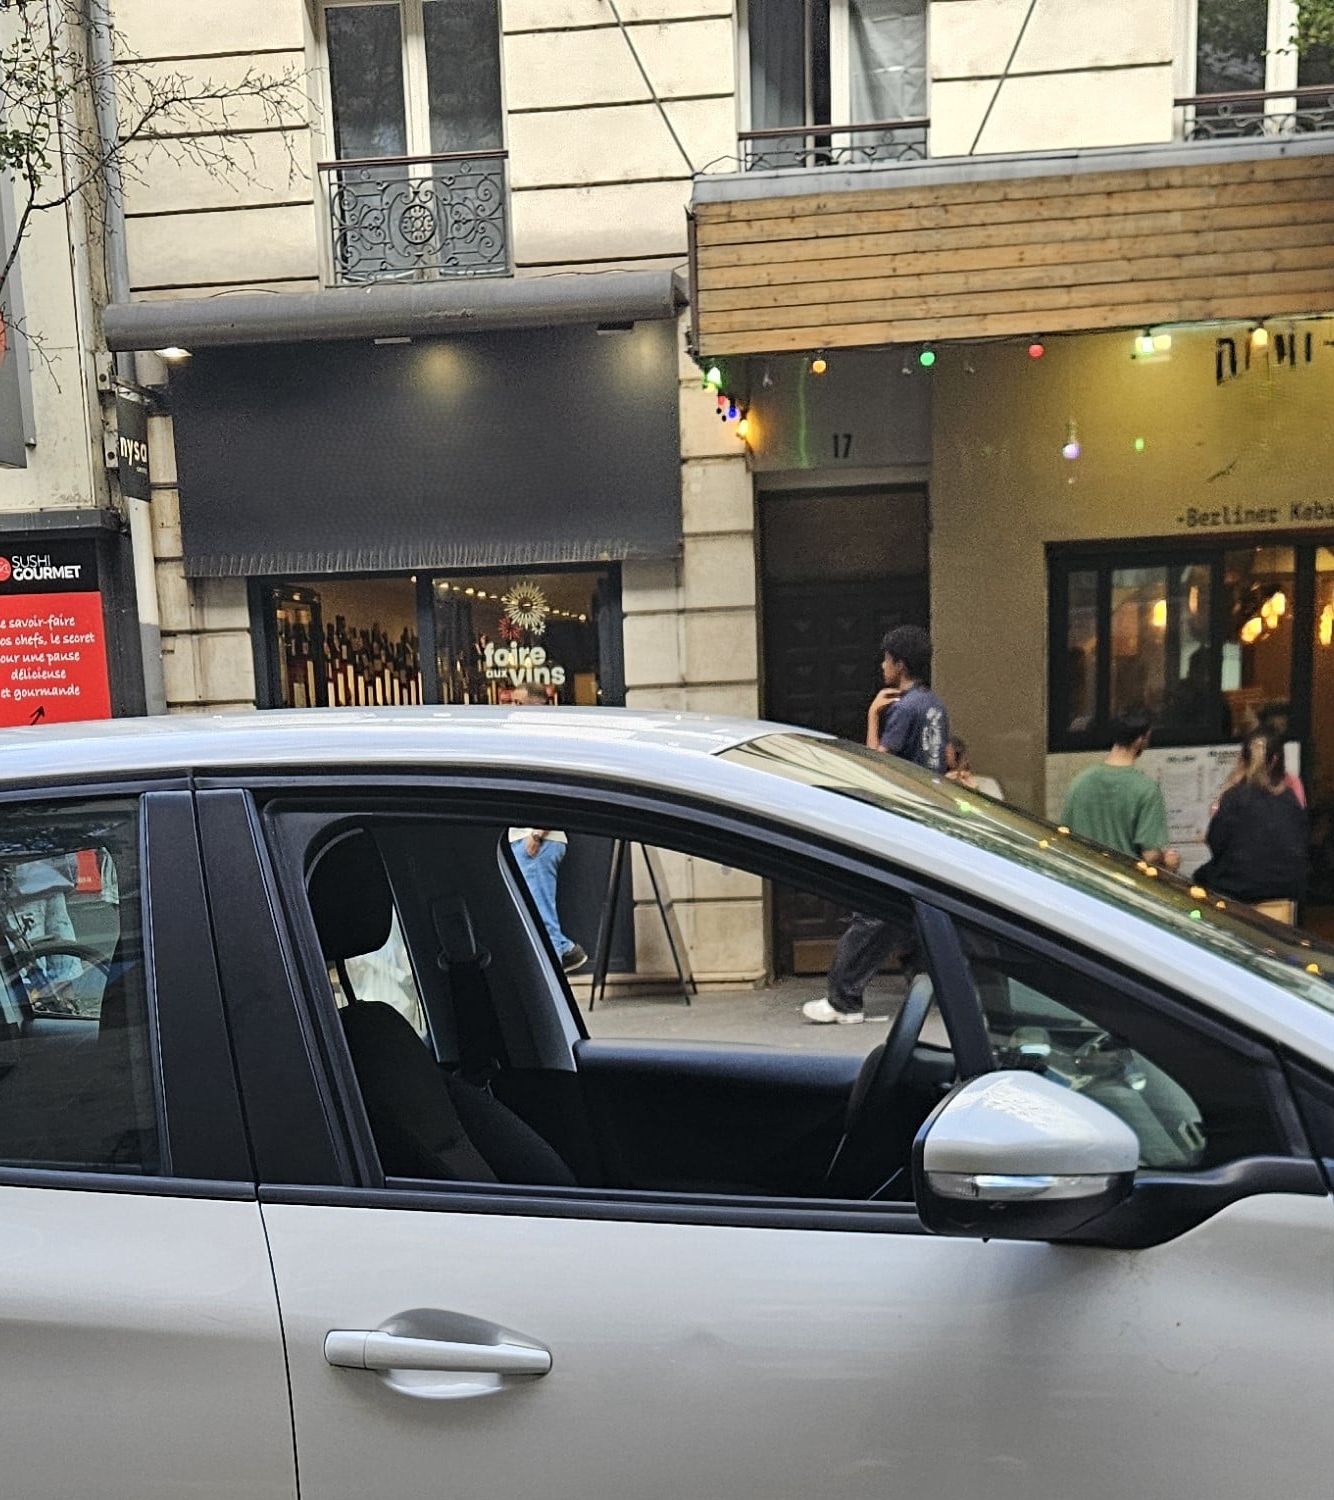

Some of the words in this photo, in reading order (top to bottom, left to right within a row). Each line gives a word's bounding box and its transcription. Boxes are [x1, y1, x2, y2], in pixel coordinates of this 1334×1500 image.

[119, 436, 148, 466] nysa
[833, 433, 852, 458] 17
[12, 555, 51, 568] SUSHI
[13, 565, 81, 581] GOURMET
[9, 614, 75, 630] savoir-faire
[15, 634, 48, 648] chefs,
[51, 634, 60, 644] le
[63, 633, 95, 643] secret
[22, 652, 45, 662] une
[48, 650, 80, 663] pause
[484, 641, 546, 667] foire
[11, 667, 66, 681] délicieuse
[486, 667, 508, 679] aux
[509, 664, 566, 687] vins
[1, 688, 11, 698] et
[13, 684, 80, 701] gourmande
